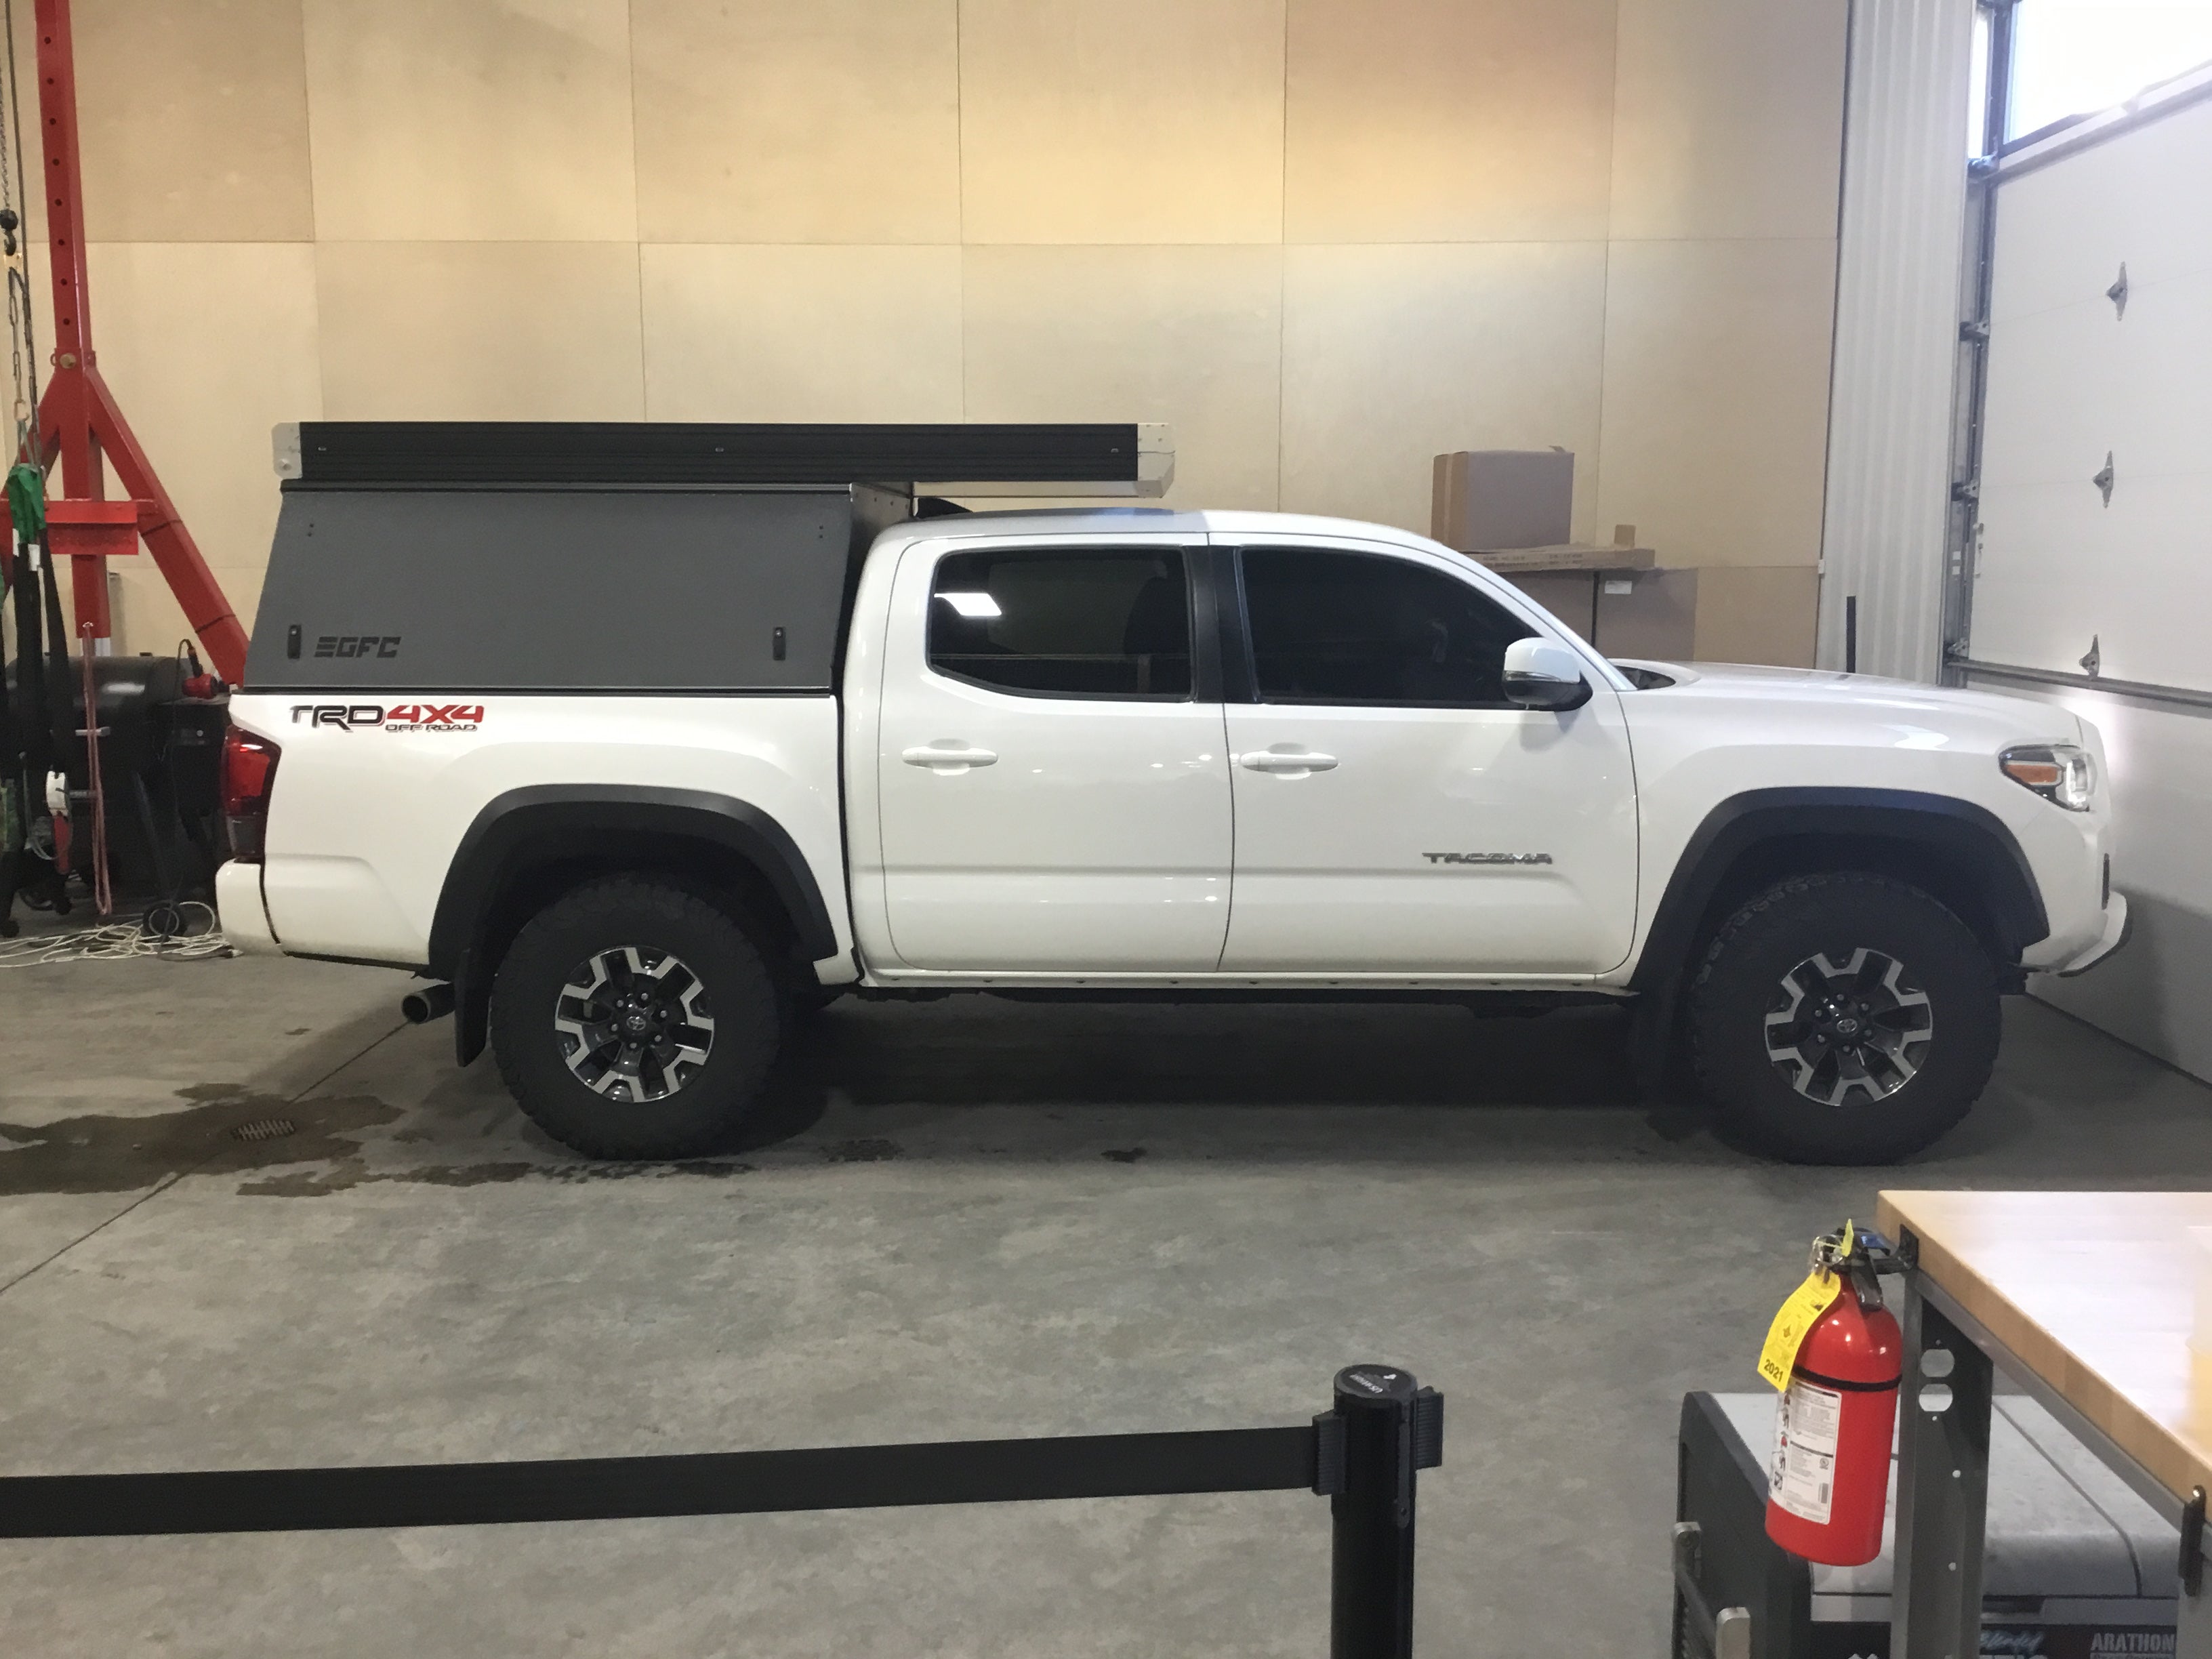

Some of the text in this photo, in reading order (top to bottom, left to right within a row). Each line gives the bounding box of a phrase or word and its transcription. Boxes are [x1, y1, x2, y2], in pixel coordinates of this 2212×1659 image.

[385, 724, 478, 733] OFF ROAD
[1421, 852, 1553, 865] TACOMA
[1763, 1358, 1784, 1382] 2021
